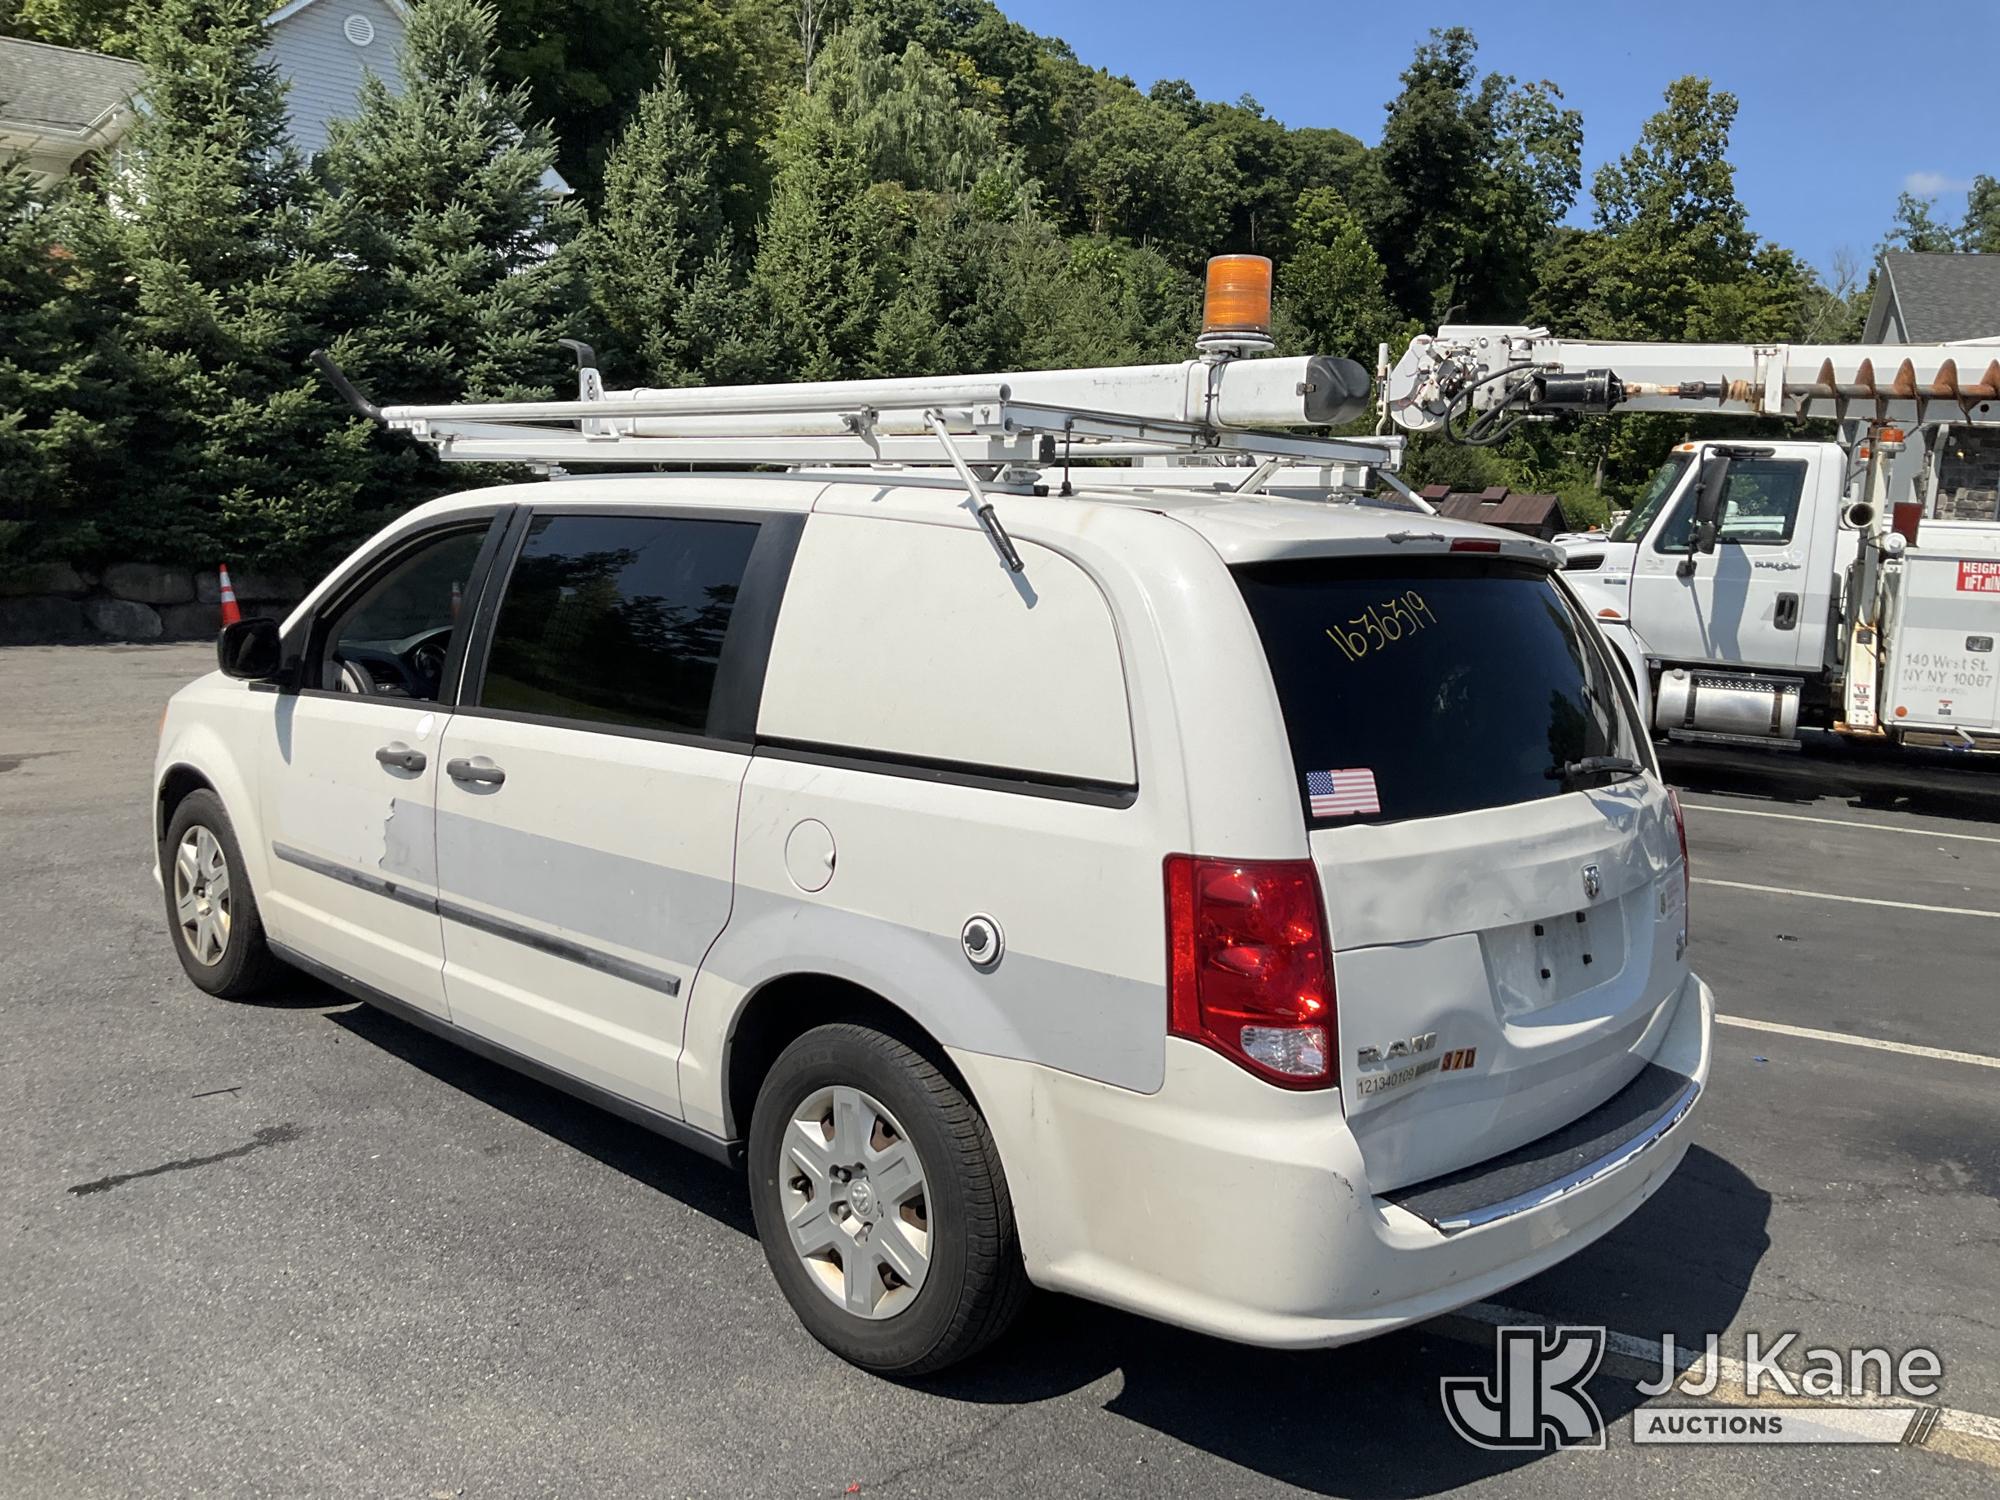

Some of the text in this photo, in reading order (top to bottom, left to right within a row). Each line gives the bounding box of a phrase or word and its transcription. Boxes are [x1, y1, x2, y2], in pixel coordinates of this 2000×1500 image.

[1905, 653, 1929, 667] 140
[1970, 658, 1989, 672] St.
[1903, 668, 1924, 681] NY
[1927, 669, 1947, 683] NY
[1357, 1068, 1415, 1095] 121340109
